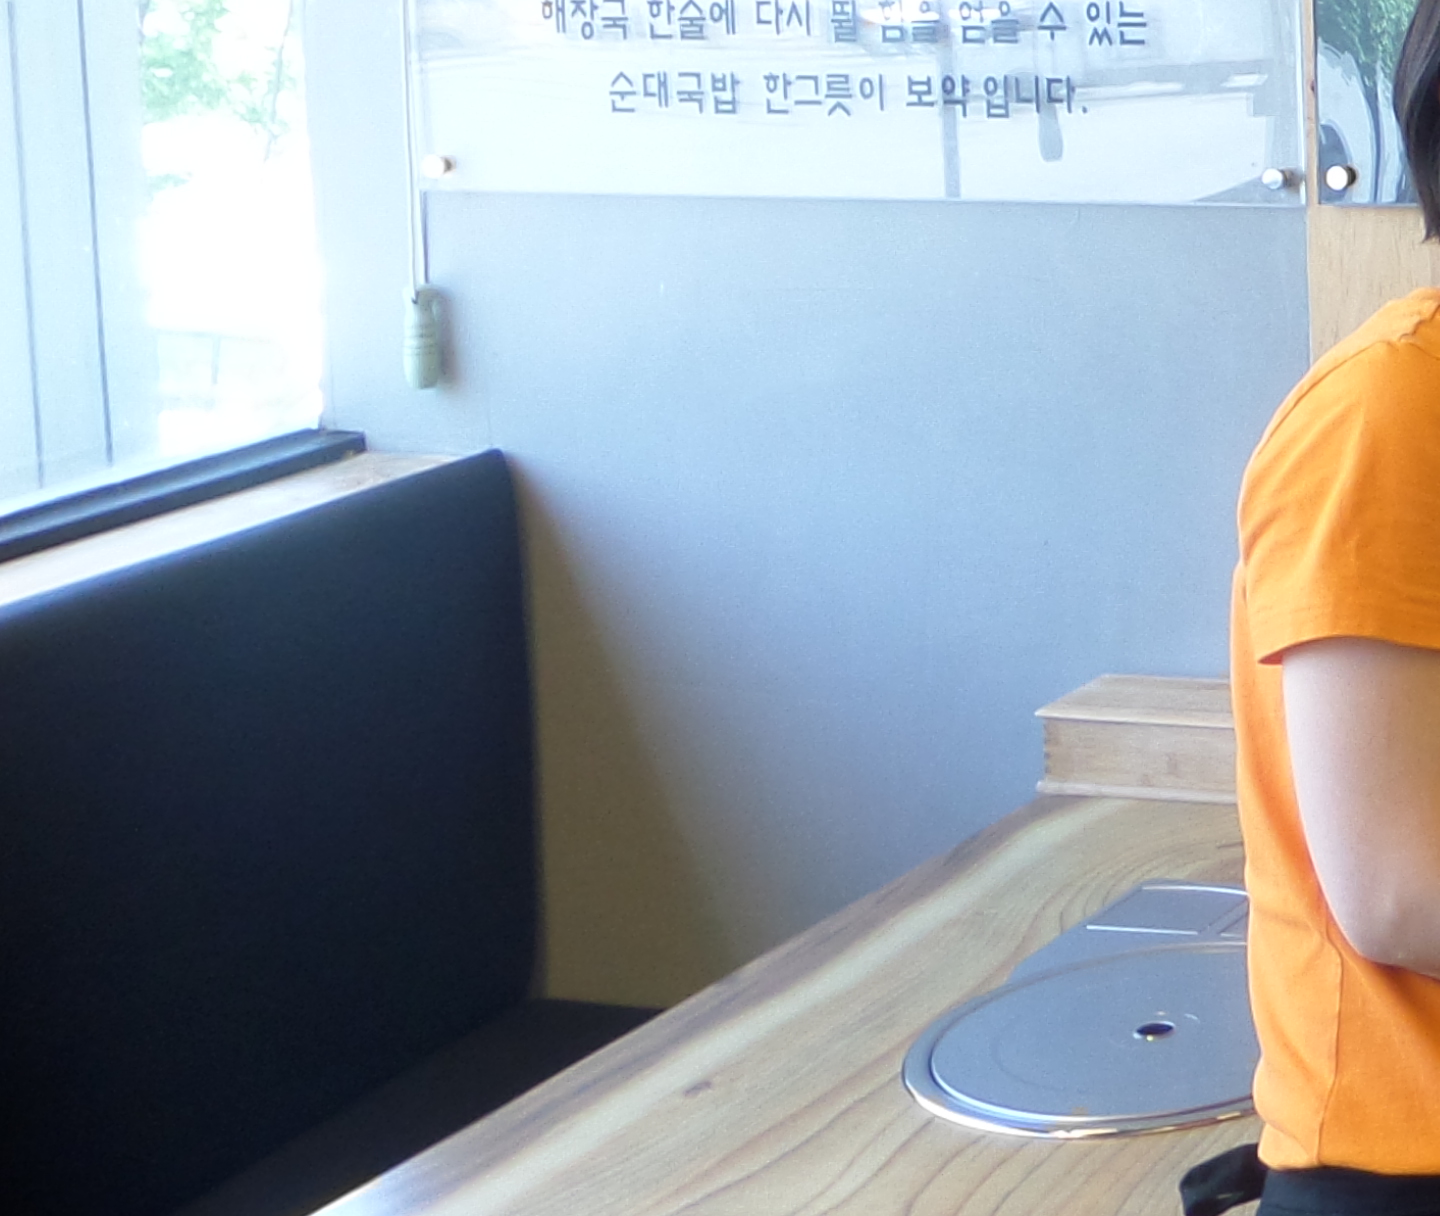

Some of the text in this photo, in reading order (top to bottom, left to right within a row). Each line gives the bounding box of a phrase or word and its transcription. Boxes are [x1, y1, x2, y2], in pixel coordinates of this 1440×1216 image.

[756, 0, 811, 36] 다시
[1038, 2, 1067, 41] 수
[1086, 1, 1148, 46] 있는
[609, 72, 741, 114] 순대국밥
[763, 73, 885, 116] 한그릇이
